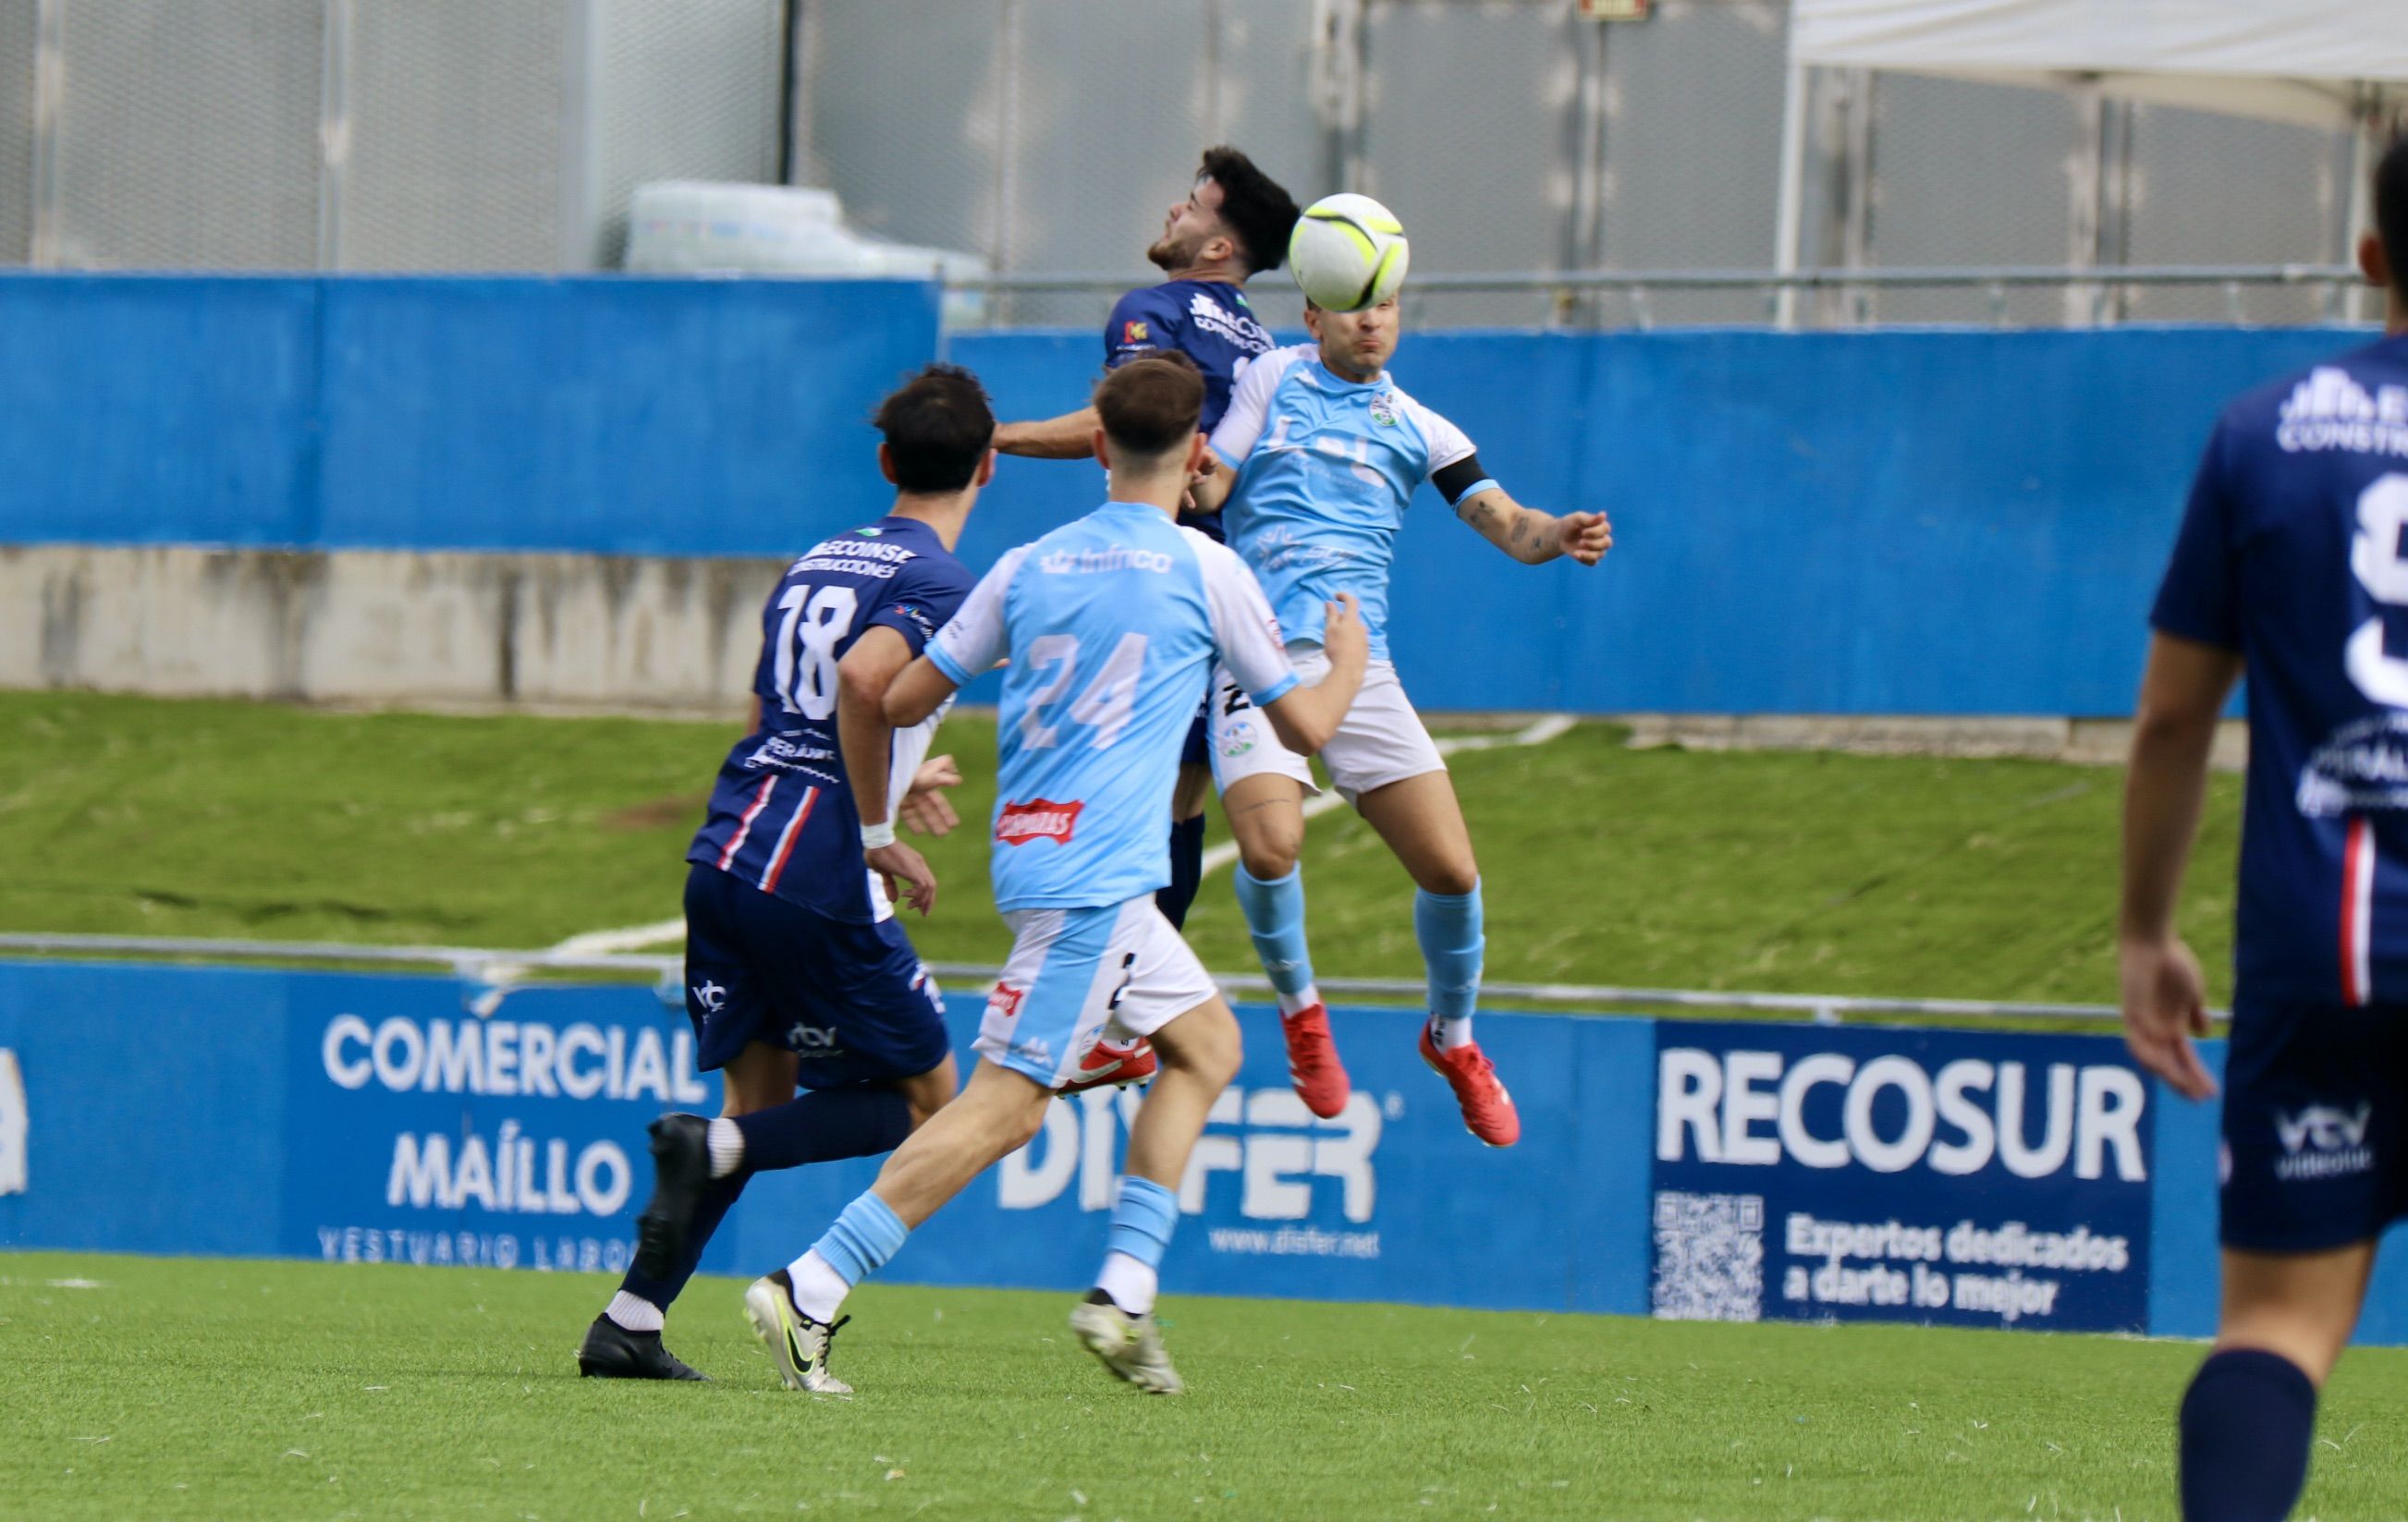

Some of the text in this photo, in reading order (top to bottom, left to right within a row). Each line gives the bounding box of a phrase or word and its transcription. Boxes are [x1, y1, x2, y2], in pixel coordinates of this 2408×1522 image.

[774, 585, 857, 720] 18
[1020, 632, 1148, 749] 24
[323, 1013, 706, 1103] COMERCIAL
[1657, 1047, 2146, 1182] RECOSUR
[387, 1117, 631, 1216] MAÍLLO
[318, 1226, 642, 1272] VESTUARIO LABO
[1786, 1212, 2129, 1272] Expertos dedicados
[1783, 1262, 2060, 1321] a darte lo mejor
